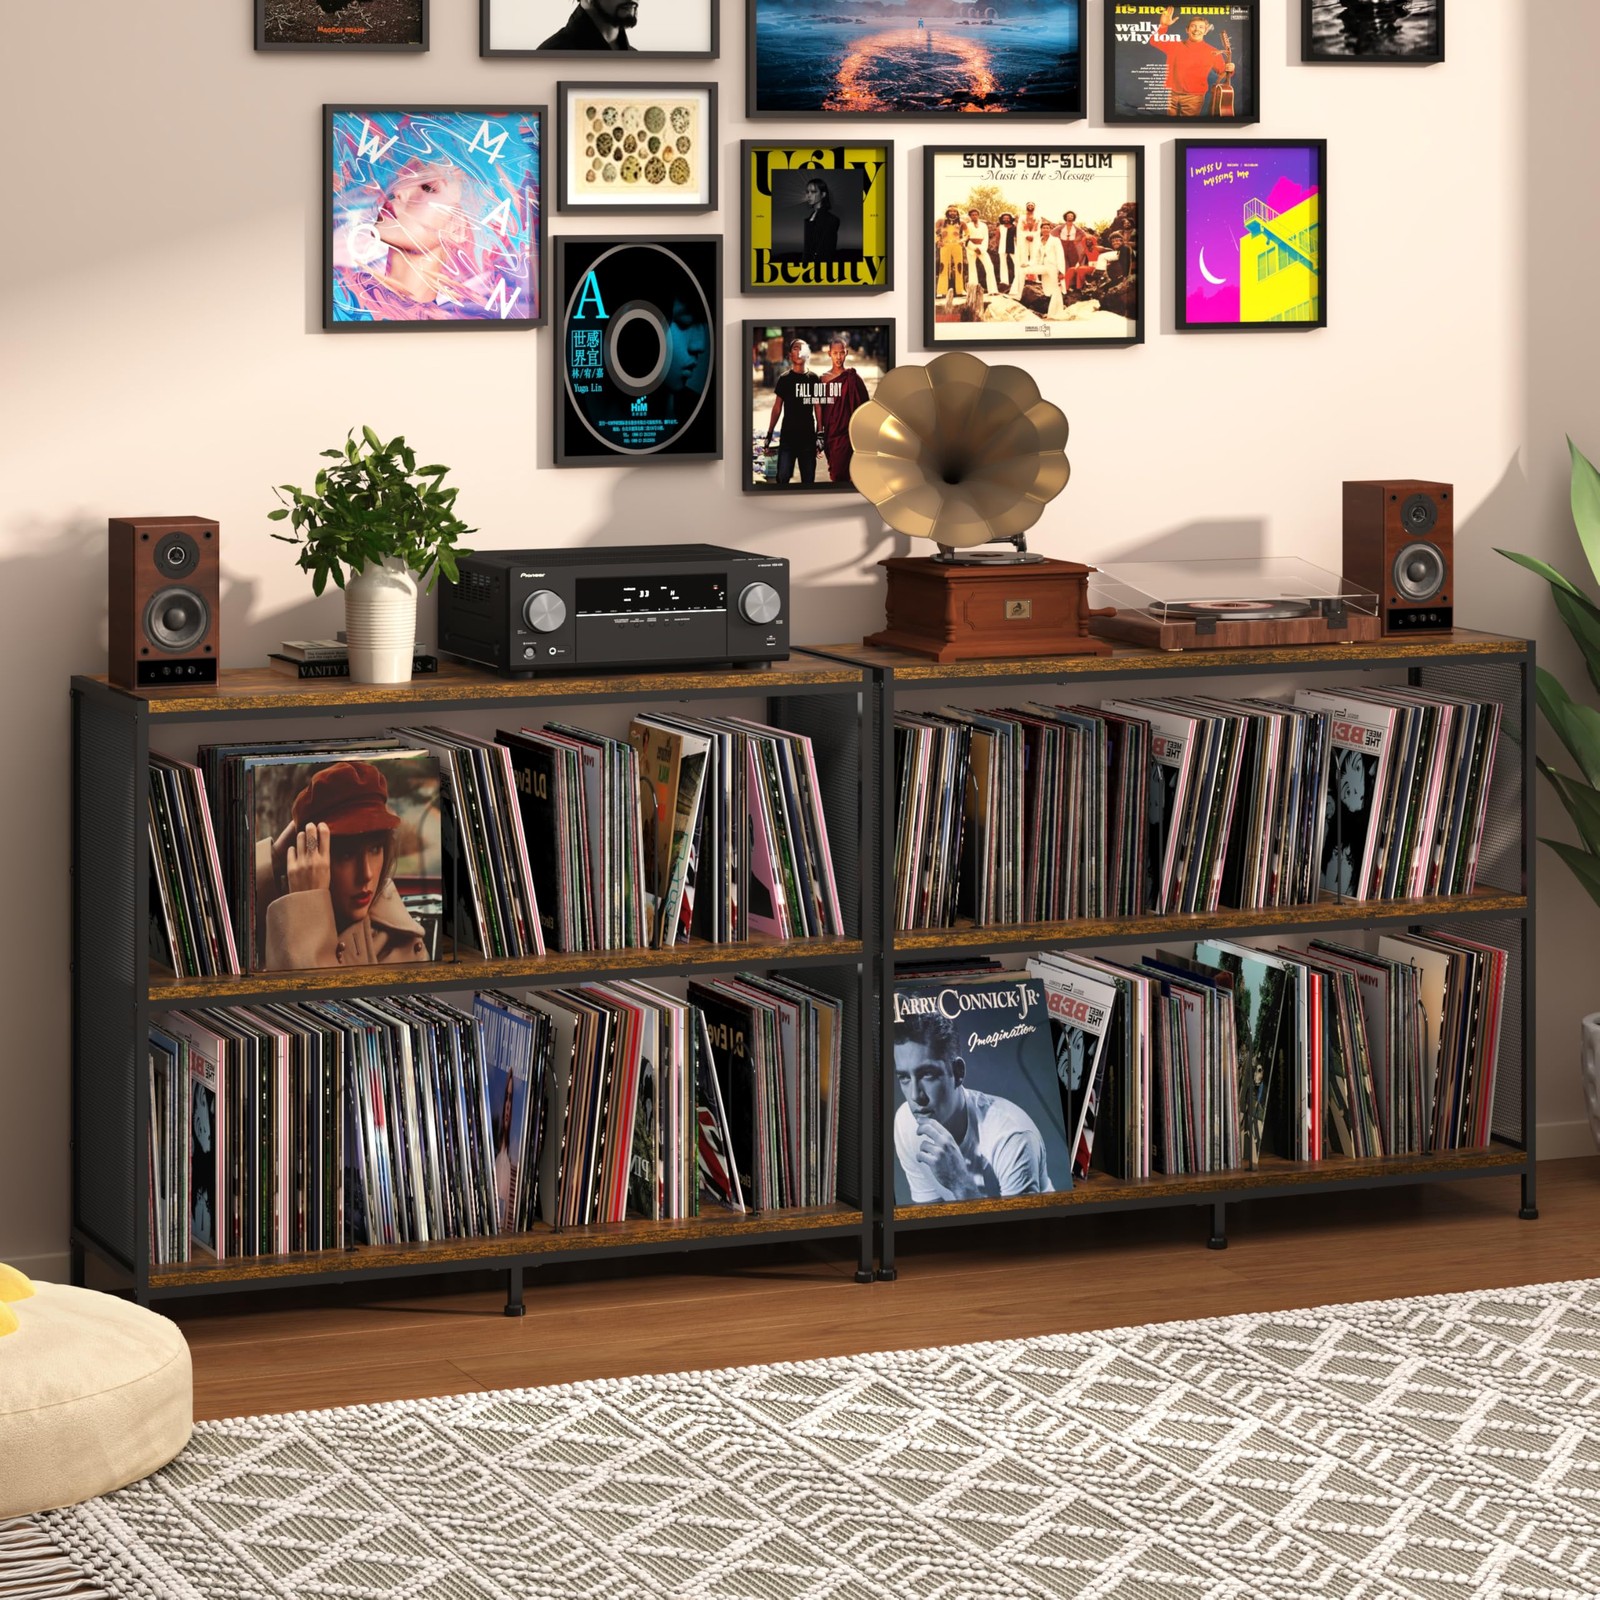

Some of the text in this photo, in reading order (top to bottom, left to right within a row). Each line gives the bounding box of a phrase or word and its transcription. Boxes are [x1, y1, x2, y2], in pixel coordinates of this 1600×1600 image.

[1115, 22, 1161, 34] wally
[1115, 32, 1182, 44] whyton
[980, 170, 1095, 182] Music is the Message
[1203, 171, 1234, 187] missing
[573, 270, 610, 319] A
[795, 382, 842, 398] FALL OUT BOY
[300, 664, 341, 676] VANITY
[968, 1023, 1037, 1053] Imagination
